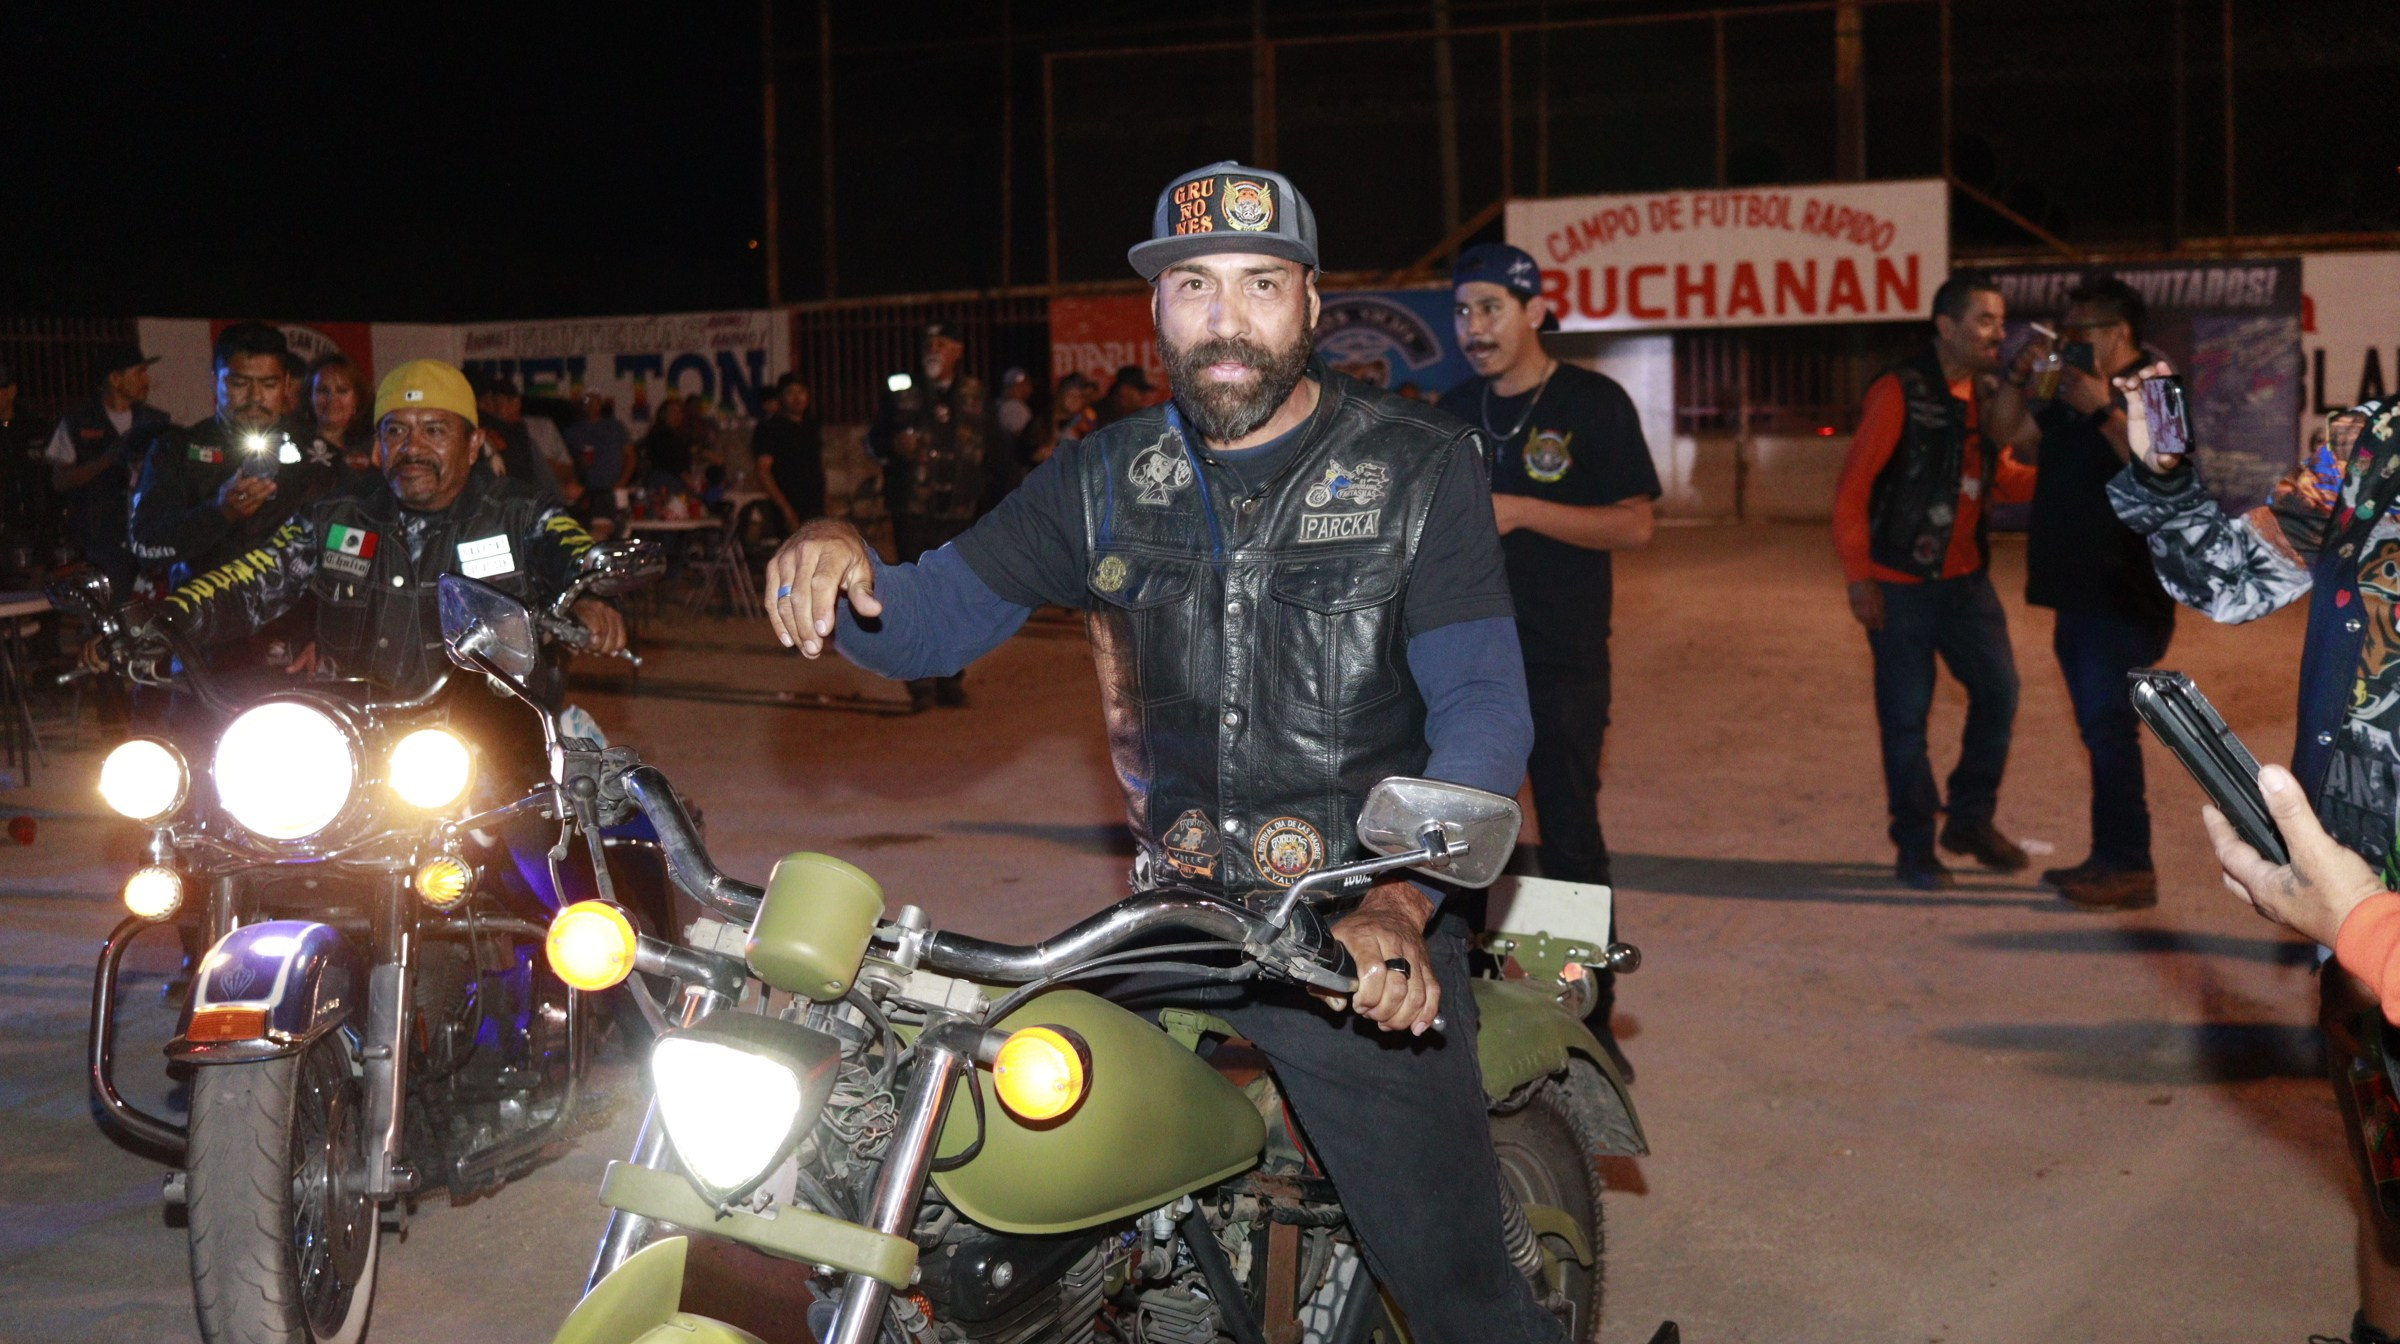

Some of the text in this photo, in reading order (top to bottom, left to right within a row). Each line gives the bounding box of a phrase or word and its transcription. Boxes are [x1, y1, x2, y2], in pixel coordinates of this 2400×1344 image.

[1174, 178, 1215, 205] GRU
[1176, 215, 1213, 235] NES
[1546, 195, 1895, 263] CAMPO DE FUTBOL RAPIDO
[1540, 254, 1920, 321] BUCHANAN
[1307, 513, 1374, 538] PARCKA
[1258, 826, 1275, 852] FESTIVAL
[1287, 820, 1297, 828] DE
[1297, 822, 1311, 834] LAS
[1309, 833, 1321, 860] MADRES
